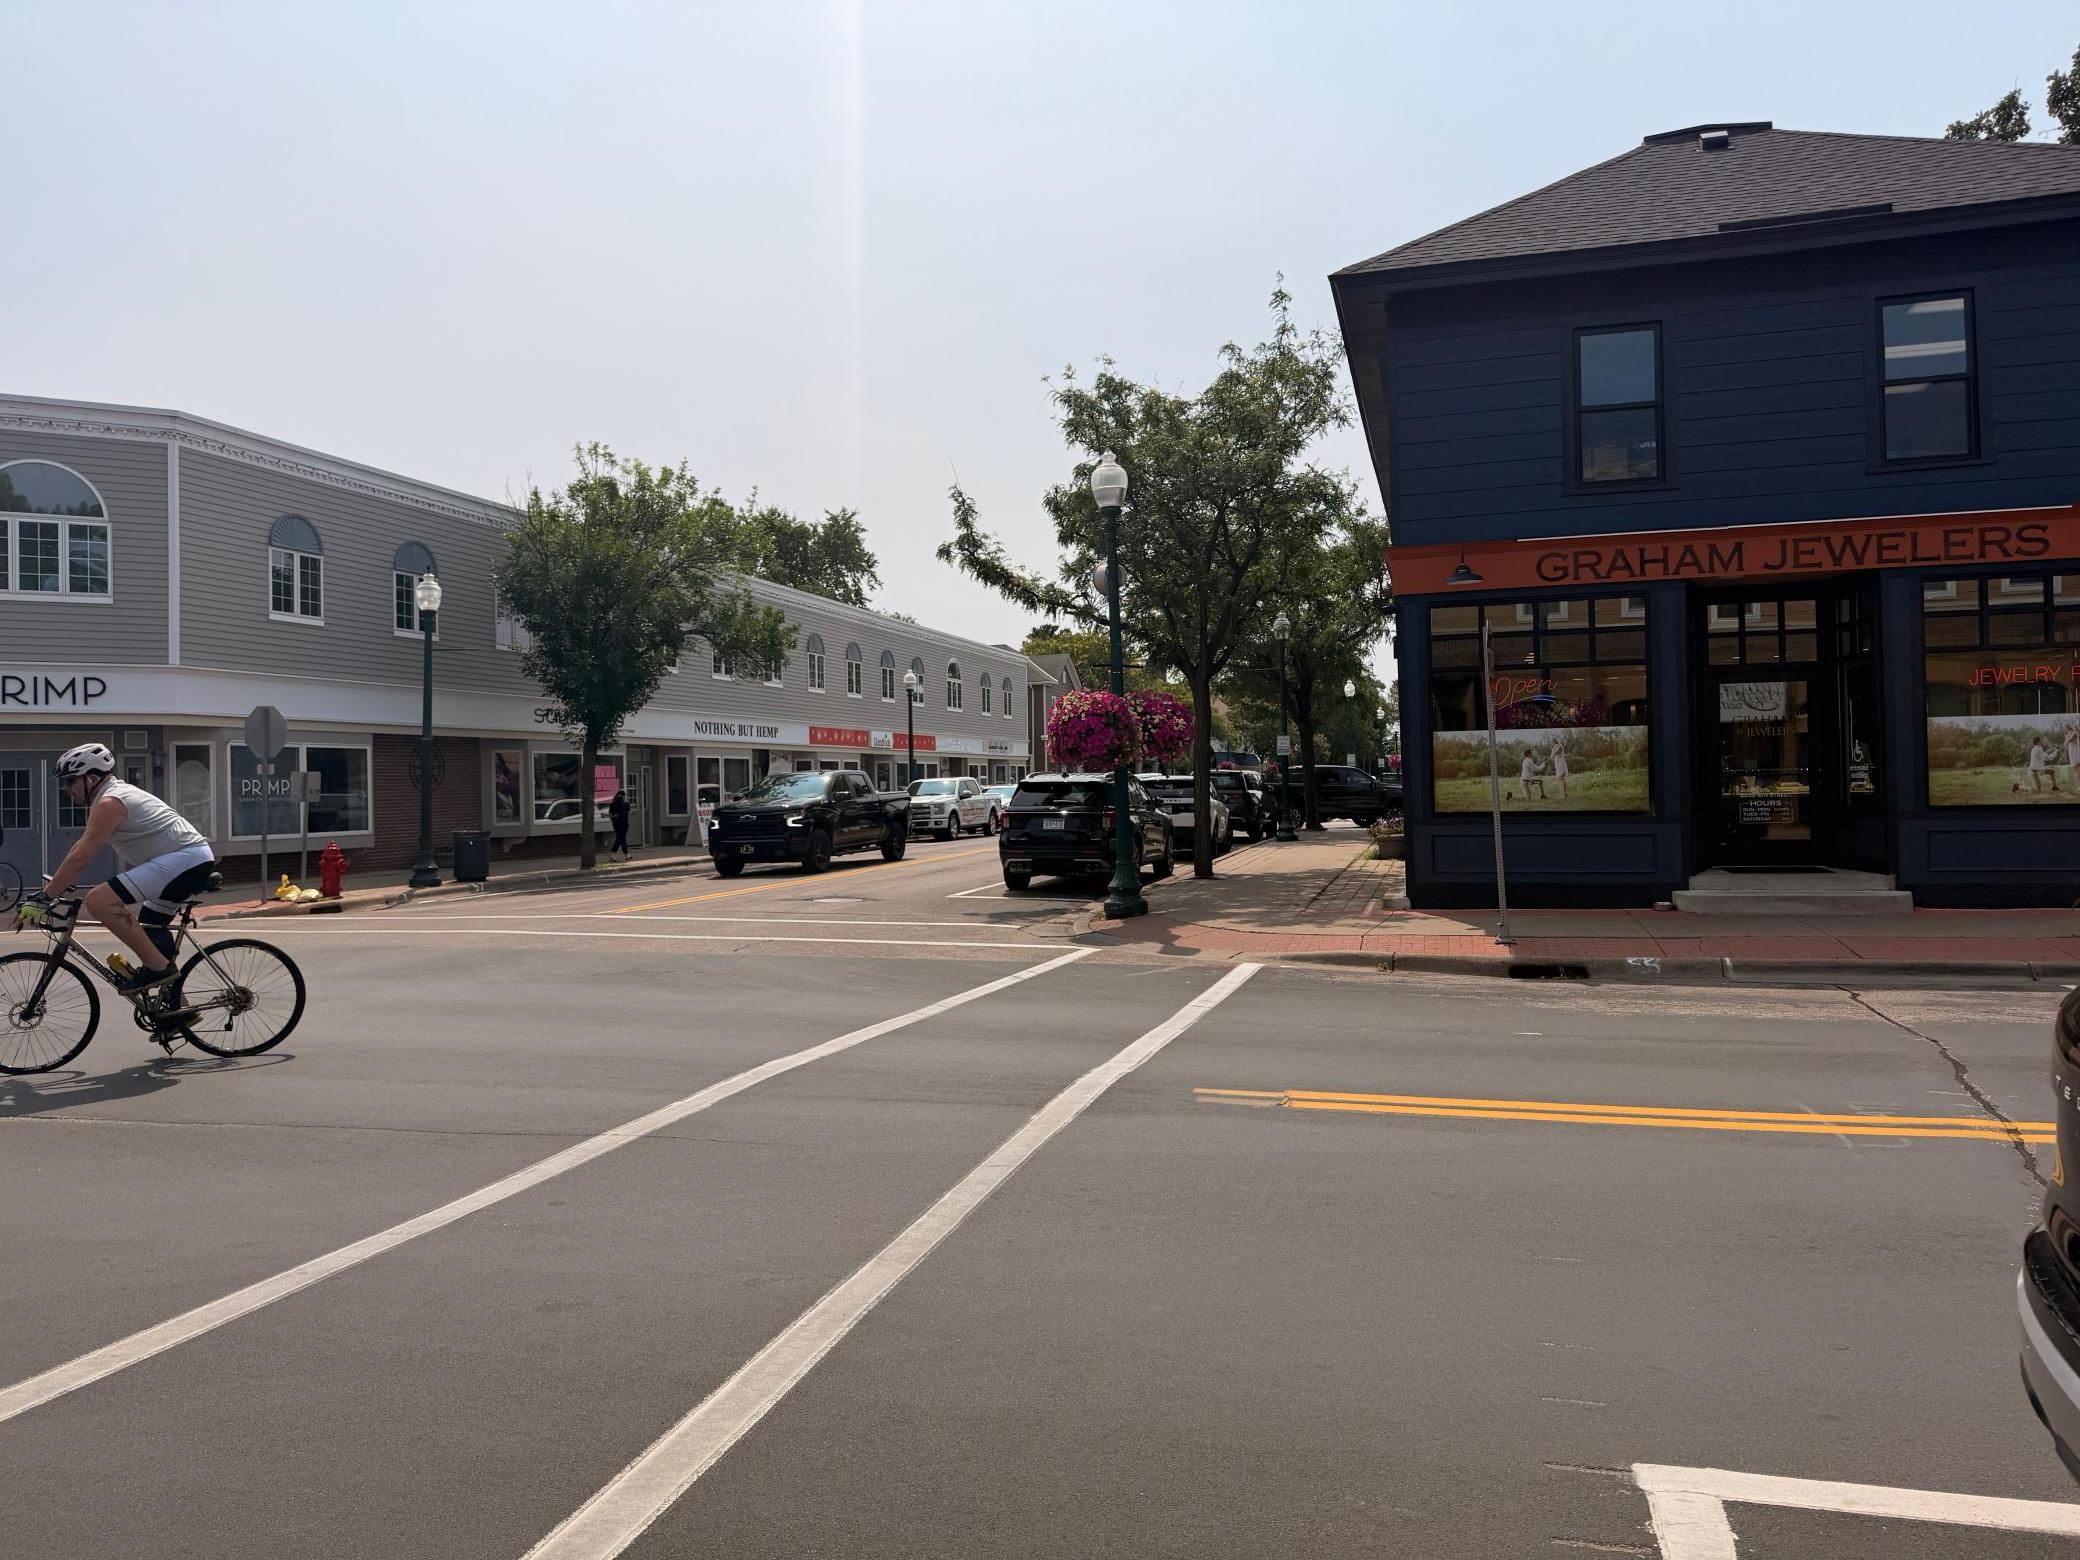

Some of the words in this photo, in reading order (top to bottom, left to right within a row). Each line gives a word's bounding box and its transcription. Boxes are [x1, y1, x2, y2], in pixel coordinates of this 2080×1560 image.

[1535, 541, 1745, 583] GRAHAM
[1761, 523, 2051, 571] JEWELERS
[1968, 665, 2061, 686] JEWELRY
[1494, 677, 1558, 709] Open
[694, 720, 735, 736] NOTHING
[738, 724, 754, 738] BUT
[756, 725, 779, 739] HEMP
[1733, 715, 1793, 726] GRAHA
[1747, 726, 1795, 737] JEWELERS
[241, 779, 290, 796] PRMP
[1750, 799, 1782, 807] HOURS
[2055, 1074, 2080, 1111] TE
